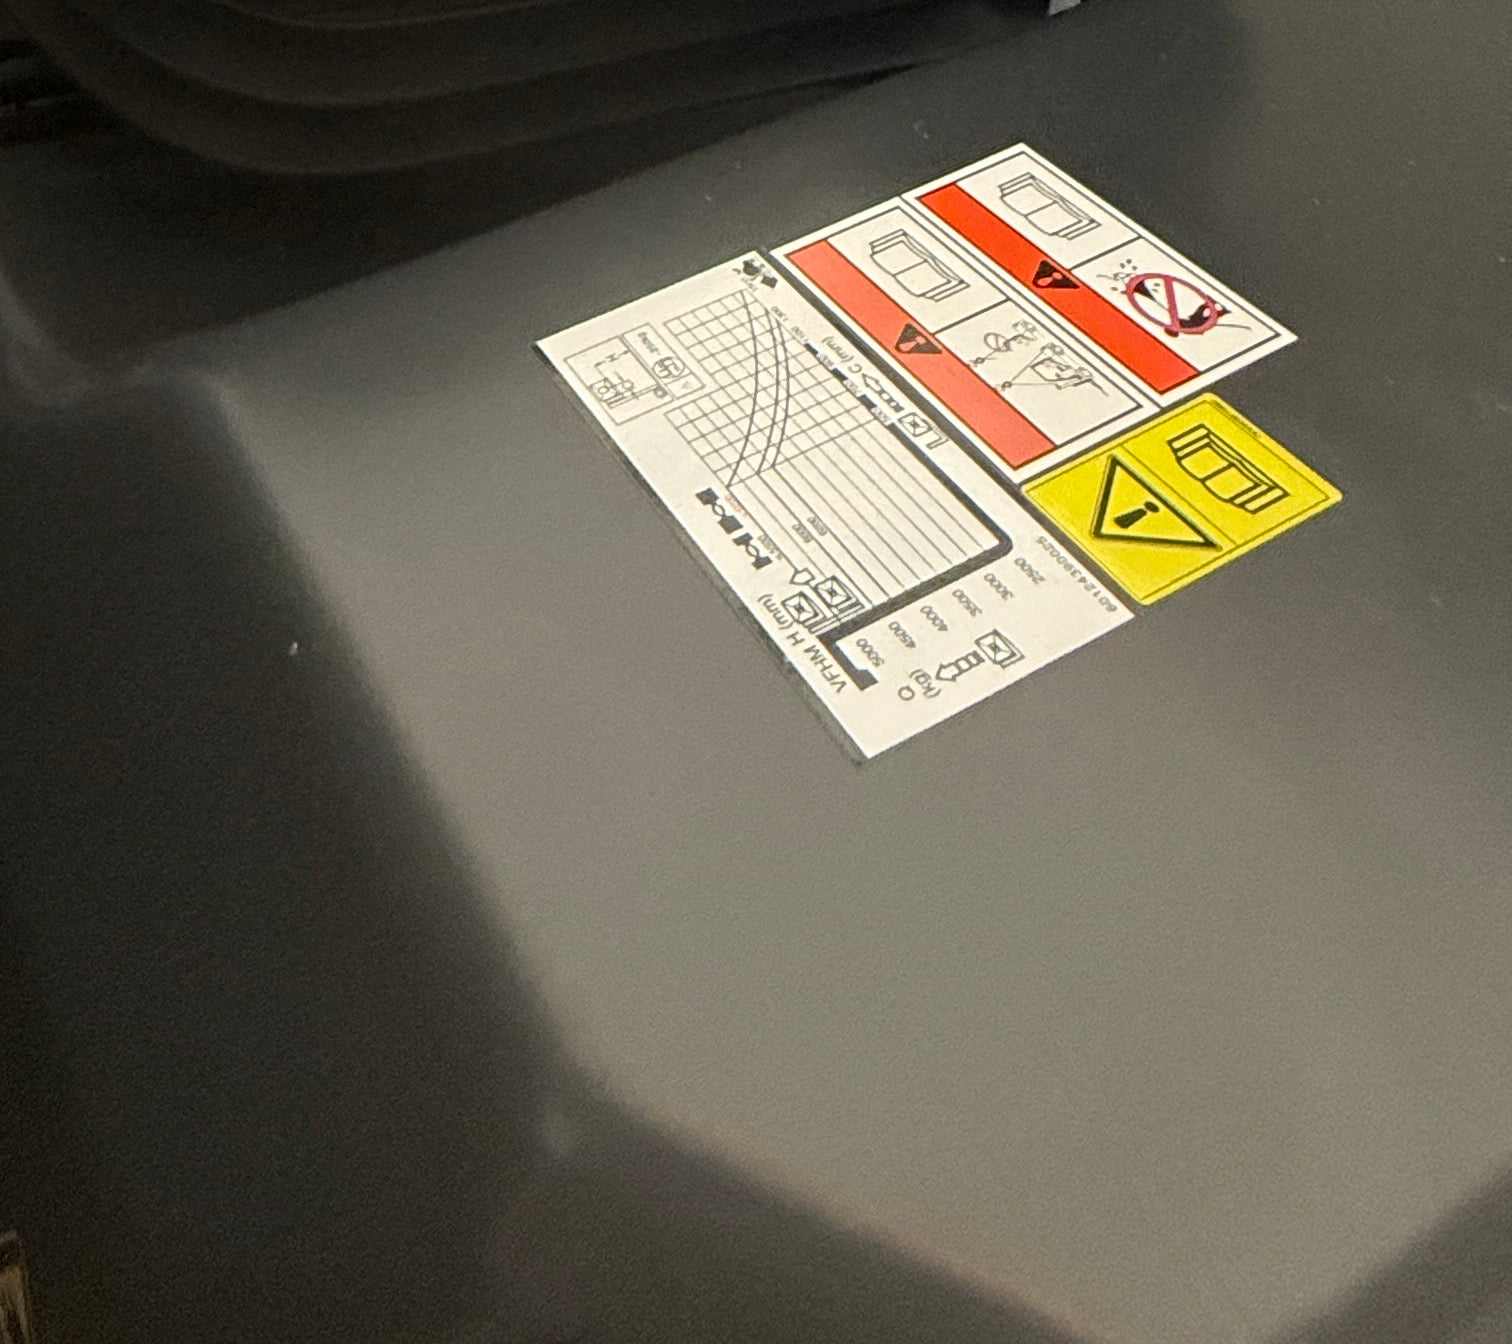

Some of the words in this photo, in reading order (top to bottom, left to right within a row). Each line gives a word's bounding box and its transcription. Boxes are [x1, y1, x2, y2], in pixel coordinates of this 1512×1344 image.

[821, 336, 854, 363] (mm)
[1013, 557, 1045, 584] 2500
[983, 573, 1013, 601] 3000
[757, 593, 794, 630] (mm)
[951, 588, 982, 617] 3500
[919, 605, 948, 631] 4000
[786, 630, 805, 646] H
[887, 621, 916, 648] 4500
[855, 638, 884, 667] 5000
[803, 644, 846, 693] VFHM
[908, 668, 942, 699] (kg)
